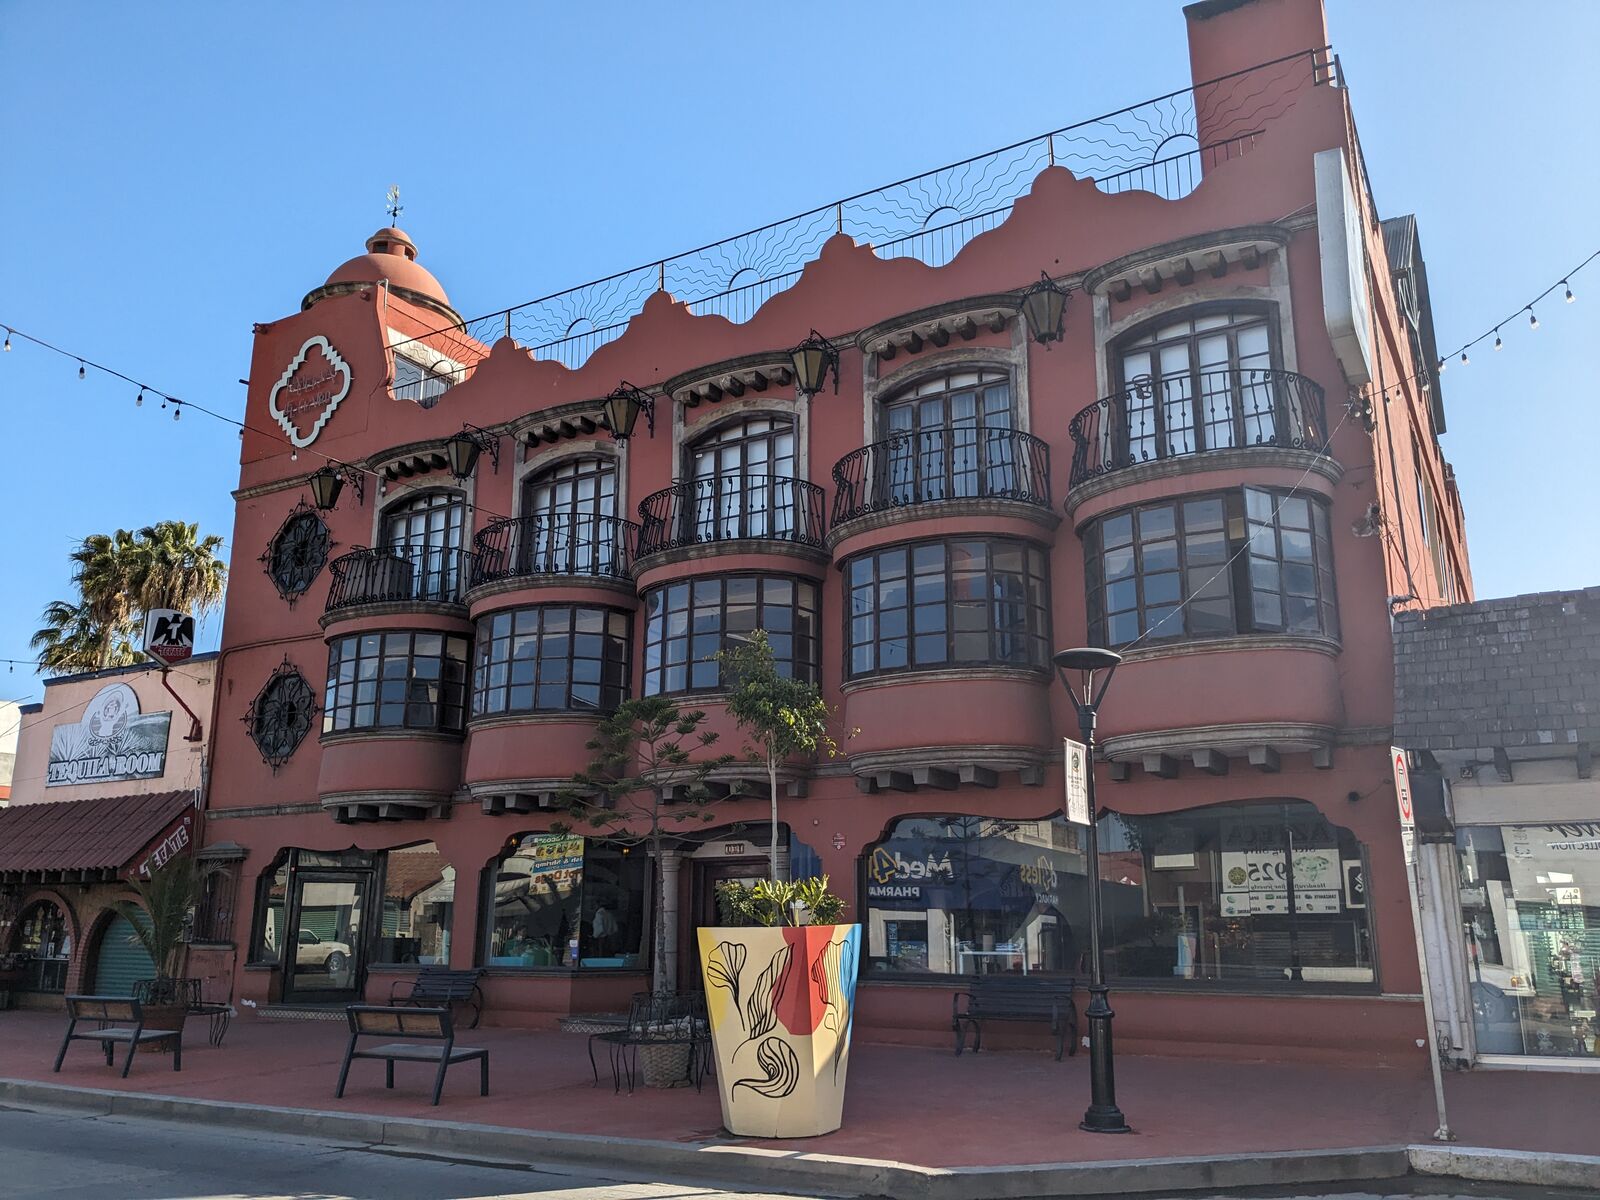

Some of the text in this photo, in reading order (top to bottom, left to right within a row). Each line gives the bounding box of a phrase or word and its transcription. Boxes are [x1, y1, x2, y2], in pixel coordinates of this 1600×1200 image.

[157, 647, 186, 657] TECATE
[48, 752, 163, 784] TEQUILA ROOM
[139, 825, 190, 879] TECATE
